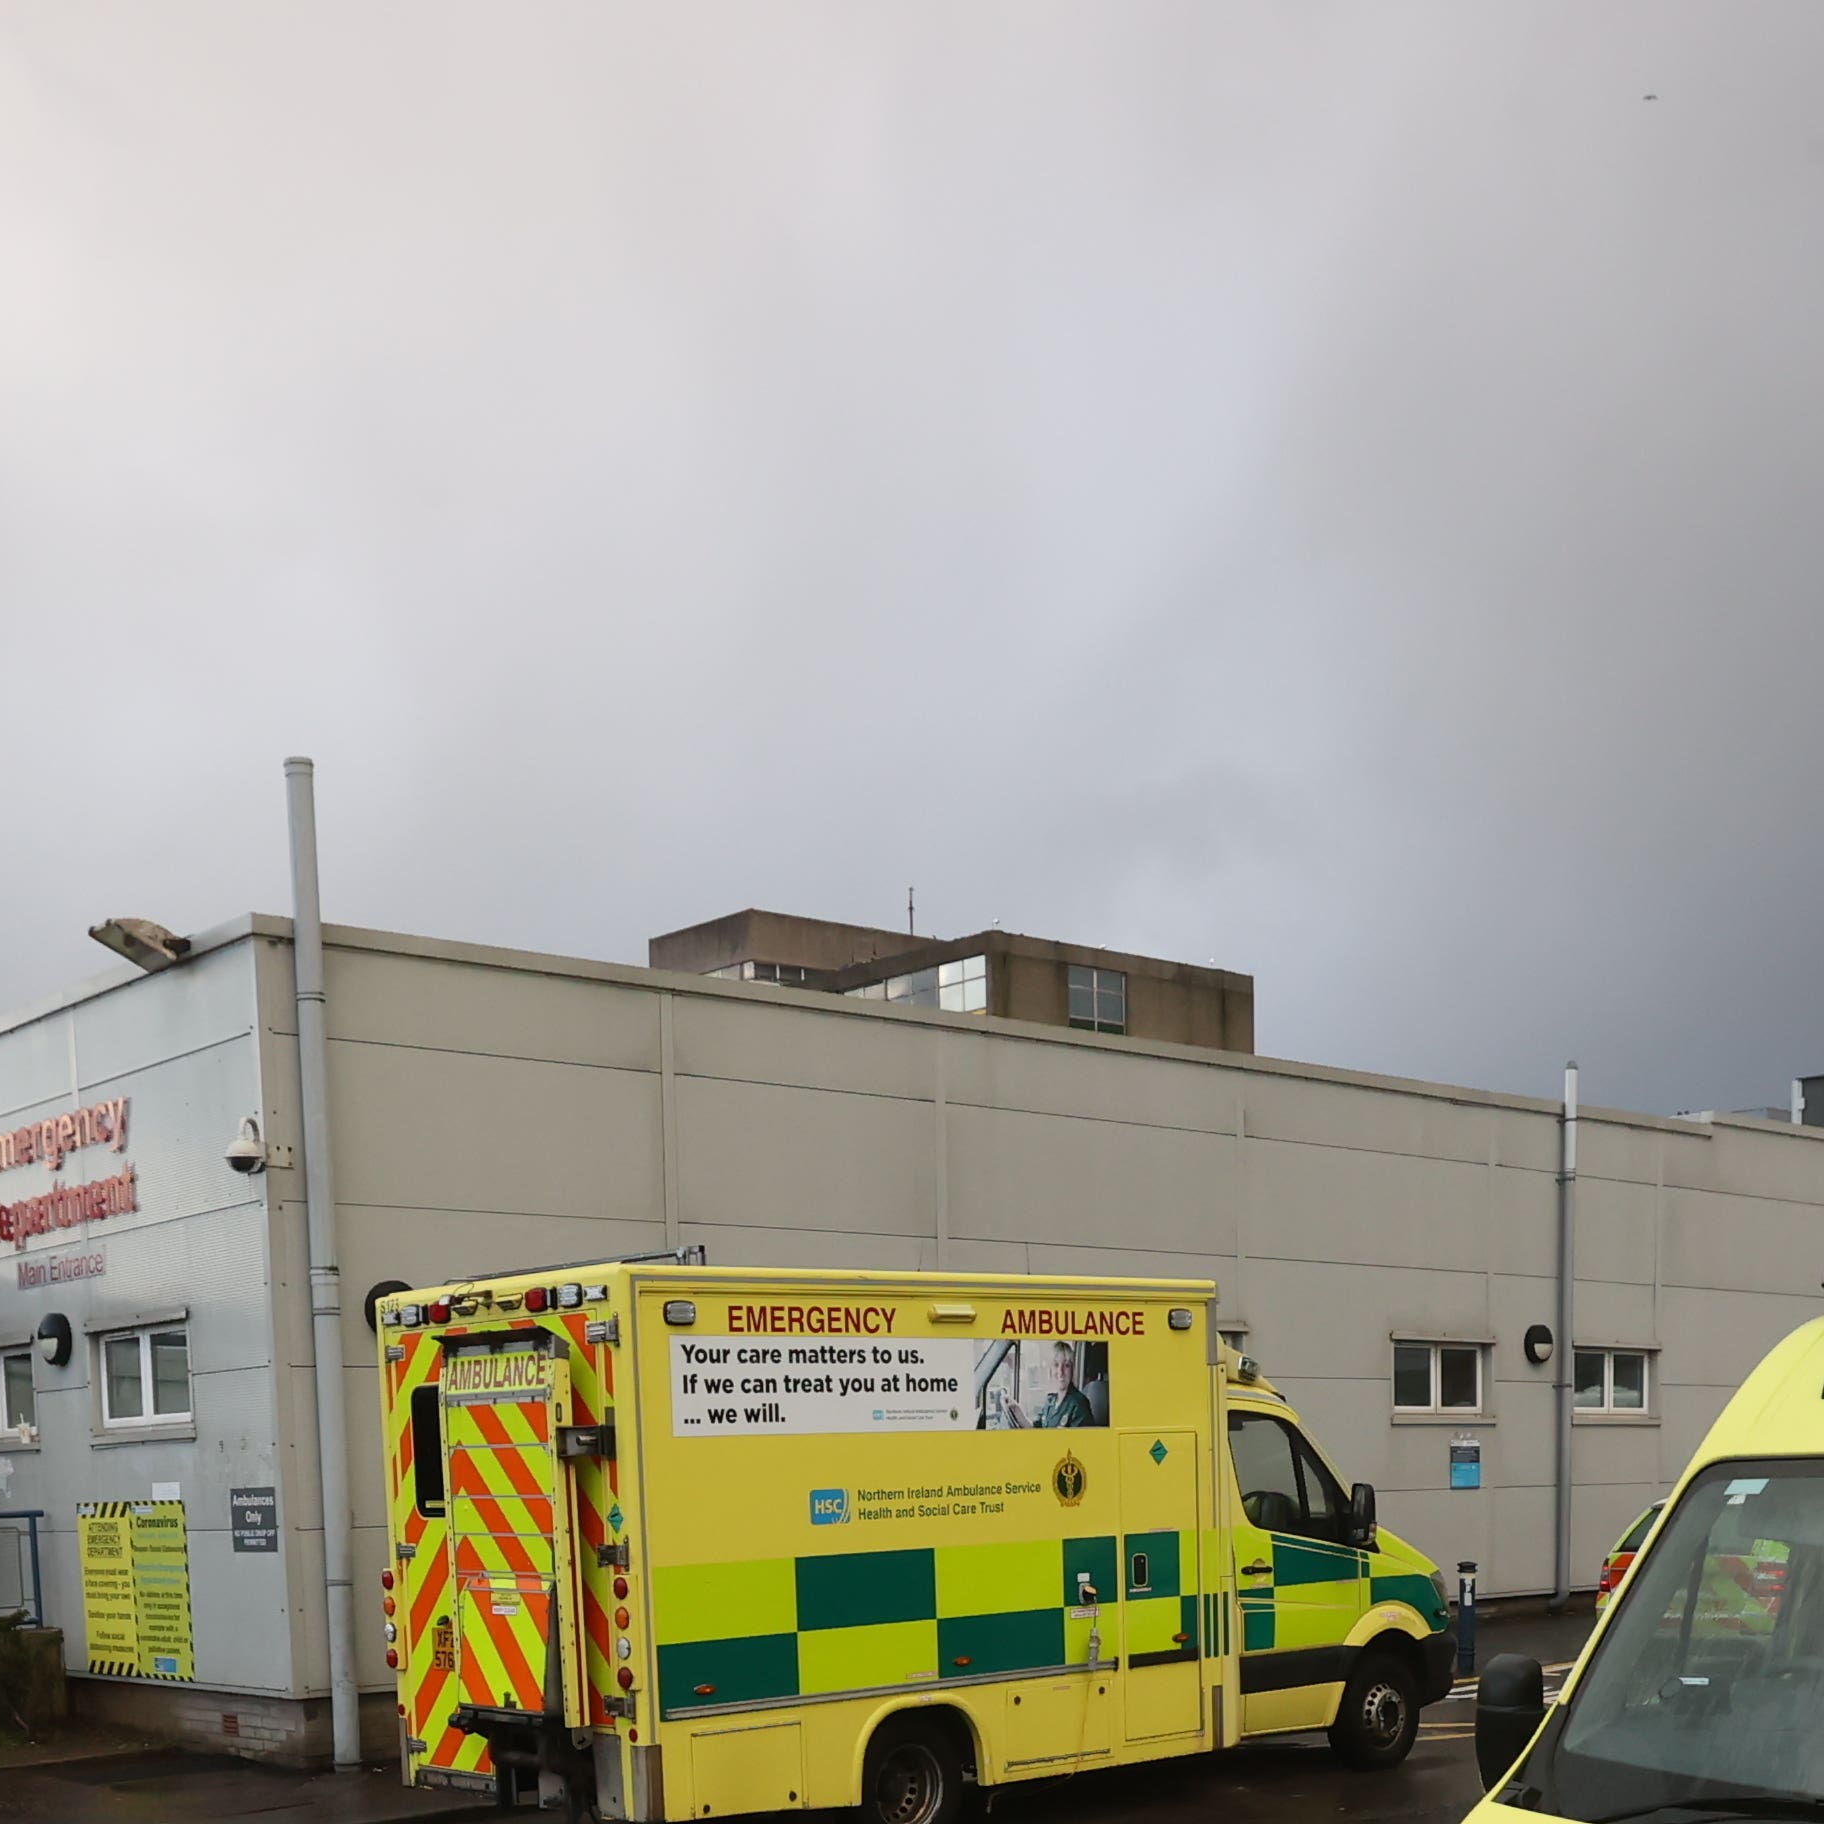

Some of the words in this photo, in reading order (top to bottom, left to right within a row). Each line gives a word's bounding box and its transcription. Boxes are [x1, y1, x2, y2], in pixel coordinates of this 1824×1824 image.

[18, 1260, 46, 1287] Main
[49, 1253, 104, 1281] Entrance
[727, 1305, 896, 1333] EMERGENCY
[1000, 1308, 1145, 1336] AMBULANCE
[681, 1344, 730, 1364] Your
[737, 1348, 782, 1364] care
[788, 1346, 866, 1364] matters
[872, 1346, 892, 1364] to
[898, 1350, 924, 1364] us.
[447, 1354, 546, 1391] AMBULANCE
[682, 1374, 698, 1394] If
[704, 1378, 734, 1394] we
[741, 1377, 778, 1393] can
[784, 1374, 833, 1393] treat
[839, 1378, 875, 1396] you
[881, 1375, 900, 1392] at
[906, 1373, 958, 1392] home
[708, 1408, 737, 1424] we
[744, 1403, 786, 1424] will.
[232, 1494, 274, 1507] Ambulances
[857, 1488, 904, 1502] Northern
[907, 1486, 943, 1500] Ireland
[946, 1484, 1003, 1498] Ambulance
[1005, 1481, 1041, 1495] Service
[814, 1498, 842, 1515] HSC
[858, 1506, 893, 1521] Health
[896, 1505, 915, 1519] and
[919, 1503, 950, 1518] Social
[953, 1502, 976, 1516] Care
[980, 1501, 1005, 1515] Trust
[136, 1516, 178, 1528] Coronavirus
[245, 1510, 262, 1525] Only
[88, 1522, 118, 1533] ATTENDING
[87, 1534, 121, 1545] EMERGENCY
[87, 1546, 123, 1558] DEPARTMENT
[435, 1650, 454, 1669] 576
